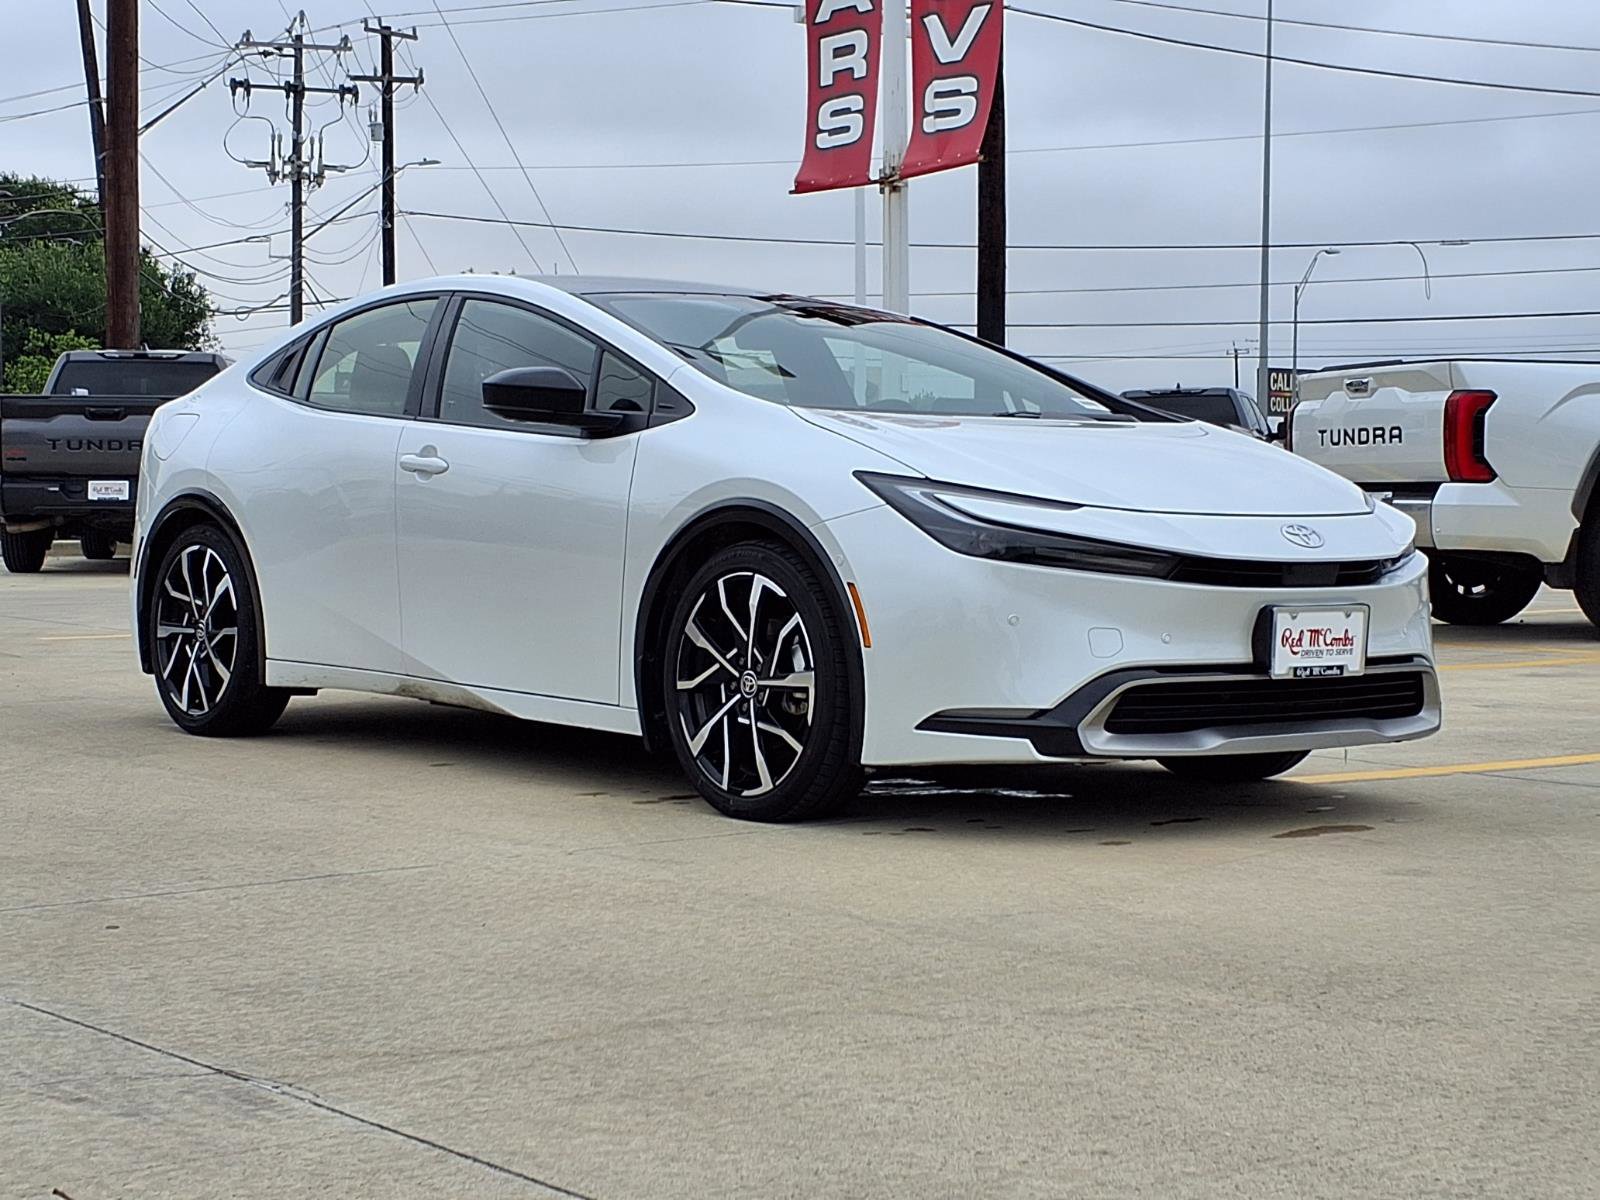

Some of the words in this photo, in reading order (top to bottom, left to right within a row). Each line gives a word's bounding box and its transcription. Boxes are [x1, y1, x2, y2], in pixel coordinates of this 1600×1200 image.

[1270, 397, 1292, 412] COLL
[1318, 426, 1402, 446] TUNDRA
[1281, 628, 1305, 656] Red
[1306, 628, 1354, 647] McCombs
[1300, 649, 1324, 657] DRIVEN
